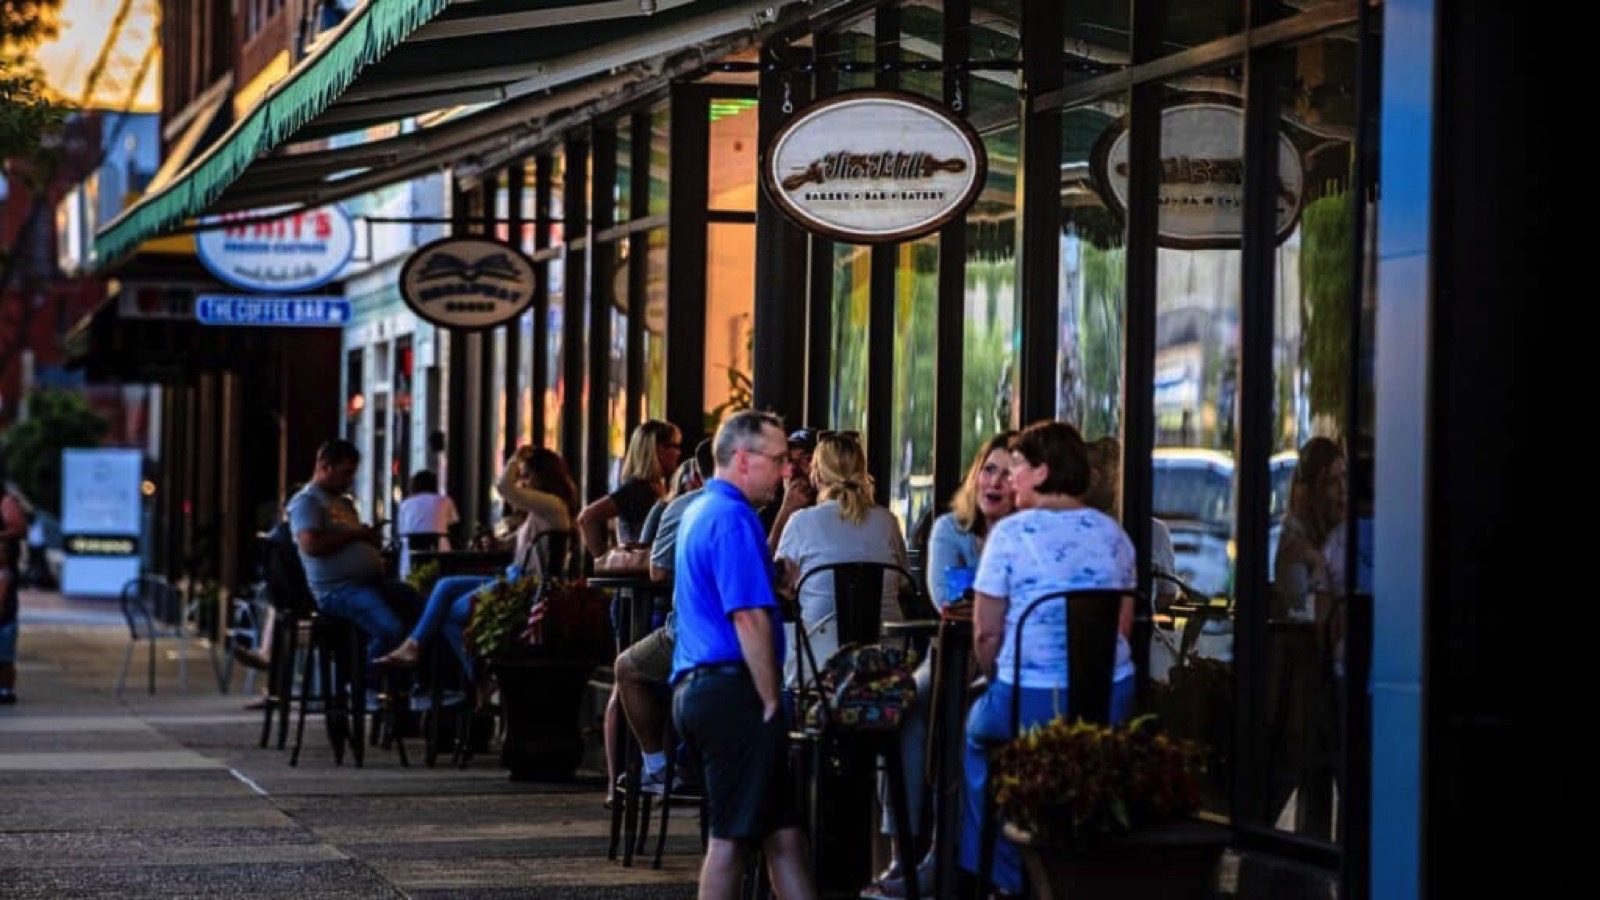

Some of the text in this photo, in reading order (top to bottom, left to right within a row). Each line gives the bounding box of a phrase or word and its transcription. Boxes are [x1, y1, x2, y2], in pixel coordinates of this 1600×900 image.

[823, 149, 925, 179] The Mill
[805, 191, 944, 200] BAKERY BAR EATERY
[294, 301, 326, 320] BAR
